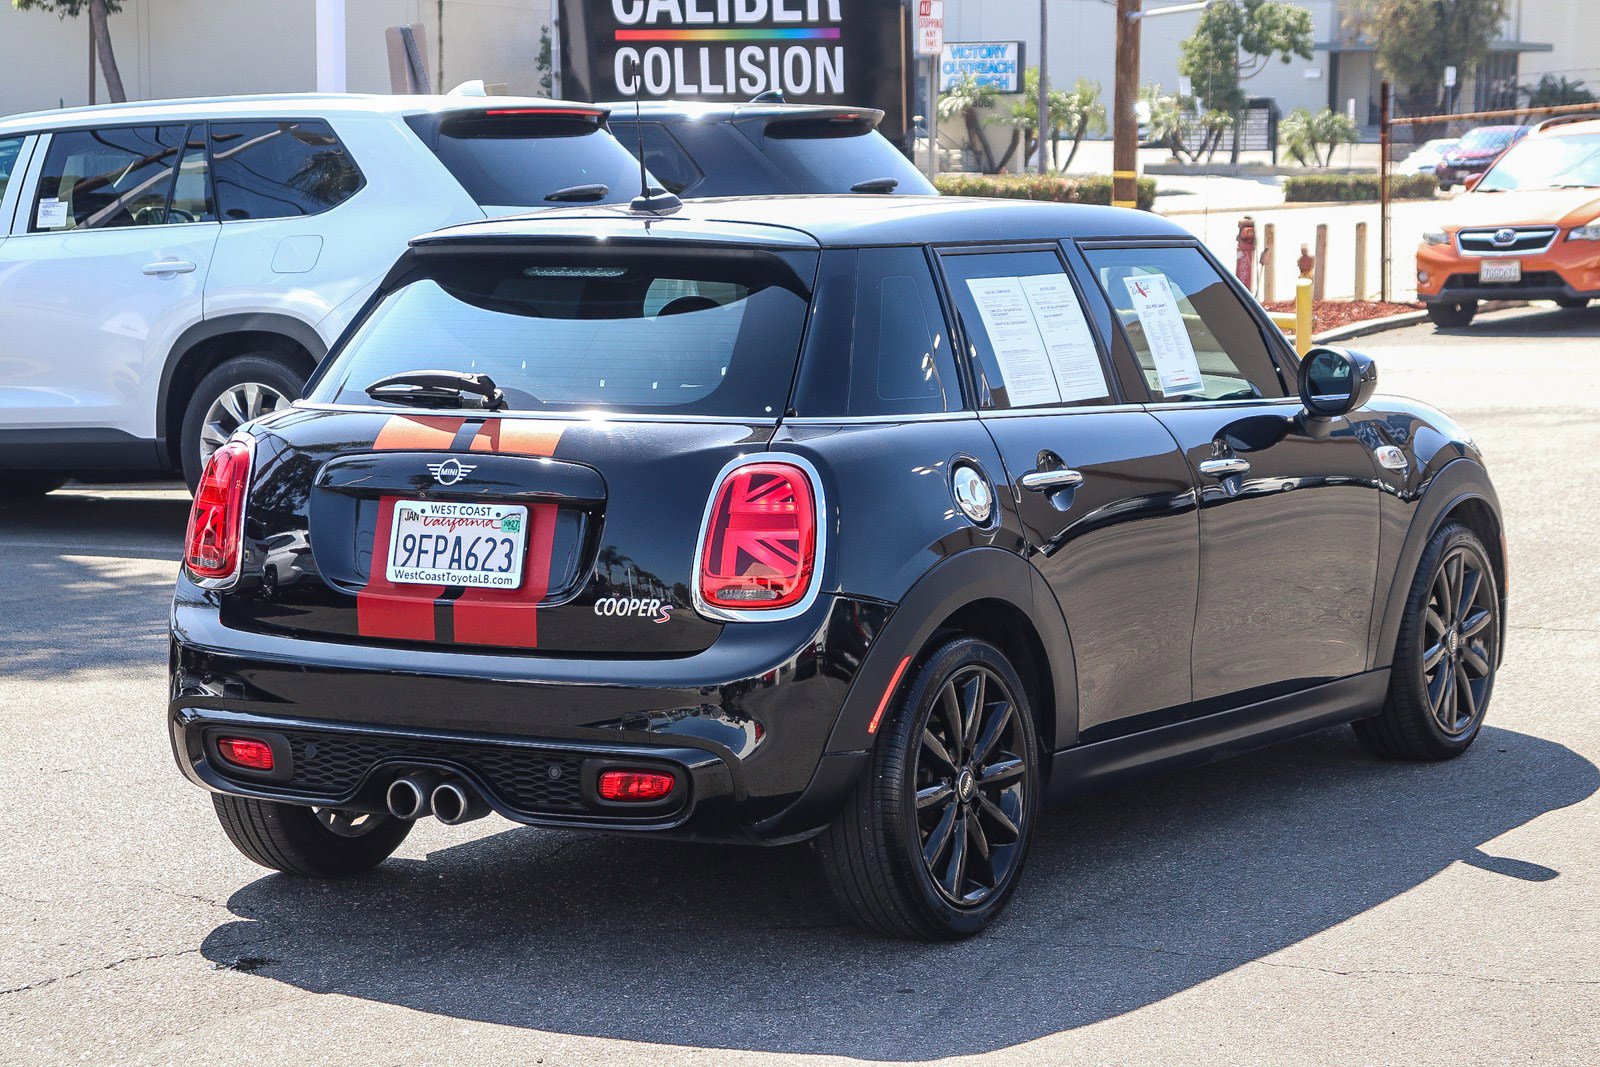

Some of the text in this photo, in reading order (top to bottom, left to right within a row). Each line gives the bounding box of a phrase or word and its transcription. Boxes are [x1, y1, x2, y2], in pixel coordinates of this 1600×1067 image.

[920, 1, 930, 15] NO
[950, 45, 1008, 59] VICTORY
[614, 46, 844, 95] COLLISION
[942, 60, 1015, 75] OUTREACH
[947, 75, 1010, 90] CRCH
[440, 468, 458, 476] MINI
[404, 510, 419, 521] JAN
[430, 504, 492, 517] WEST COAST
[401, 533, 514, 573] 9FPA623
[394, 569, 513, 586] WestCoastToyotaLB.com
[594, 597, 674, 624] COOPER S
